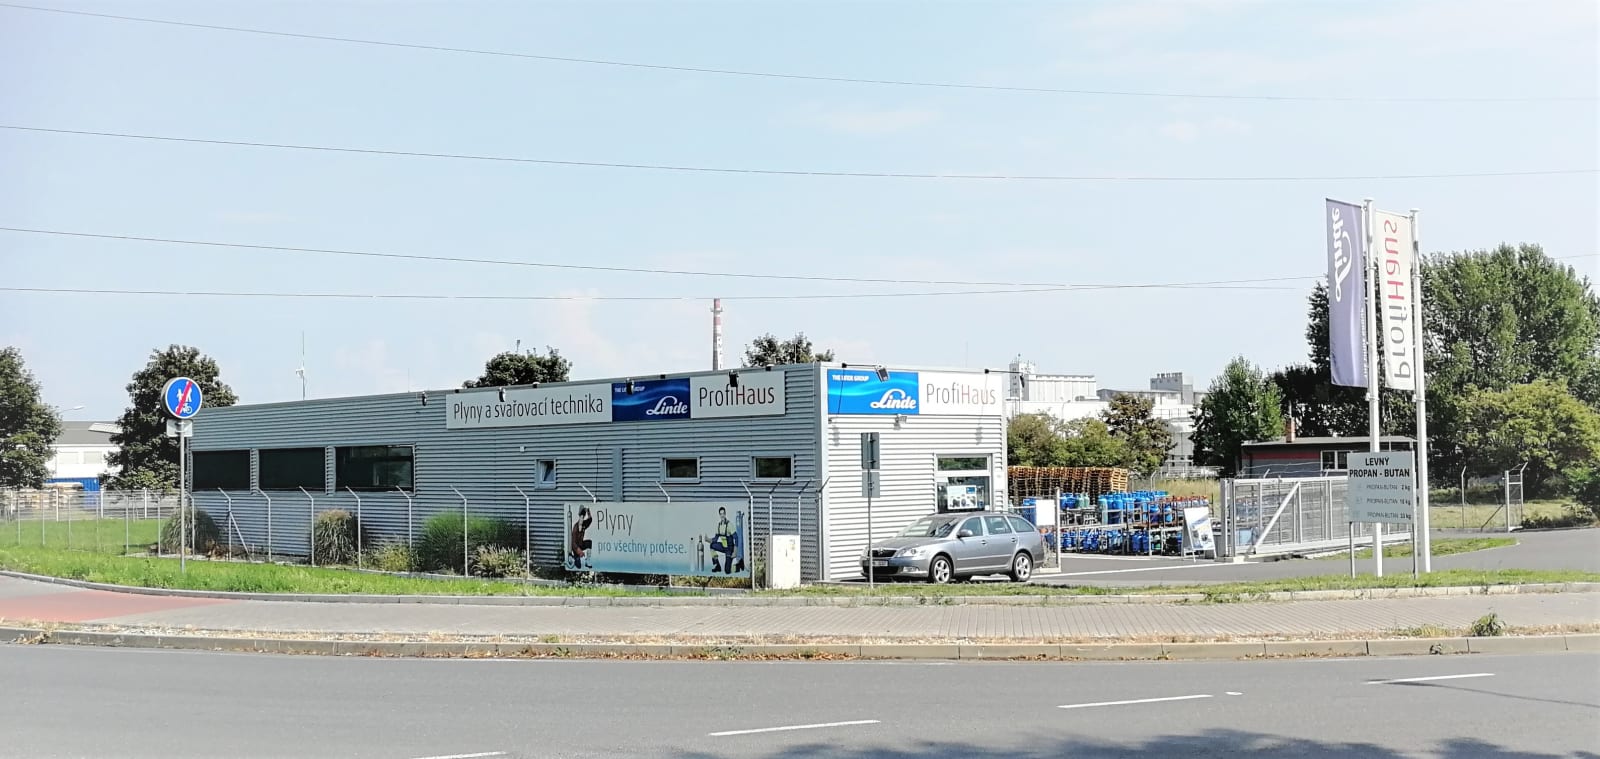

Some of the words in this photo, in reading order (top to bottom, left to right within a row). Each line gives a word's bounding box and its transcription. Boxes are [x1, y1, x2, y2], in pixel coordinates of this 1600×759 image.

[699, 384, 775, 407] ProfiHaus
[870, 388, 917, 409] Linde
[926, 382, 996, 405] ProfiHaus
[454, 401, 483, 424] Plyny
[485, 404, 491, 418] a
[494, 397, 548, 418] svařovací
[551, 393, 603, 415] technika
[646, 395, 688, 415] Linde
[1349, 469, 1377, 478] PROPAN
[1384, 468, 1410, 477] BUTAN
[596, 508, 634, 537] Plyny
[597, 541, 611, 555] pro
[613, 539, 648, 556] všechny
[650, 540, 687, 556] profese.
